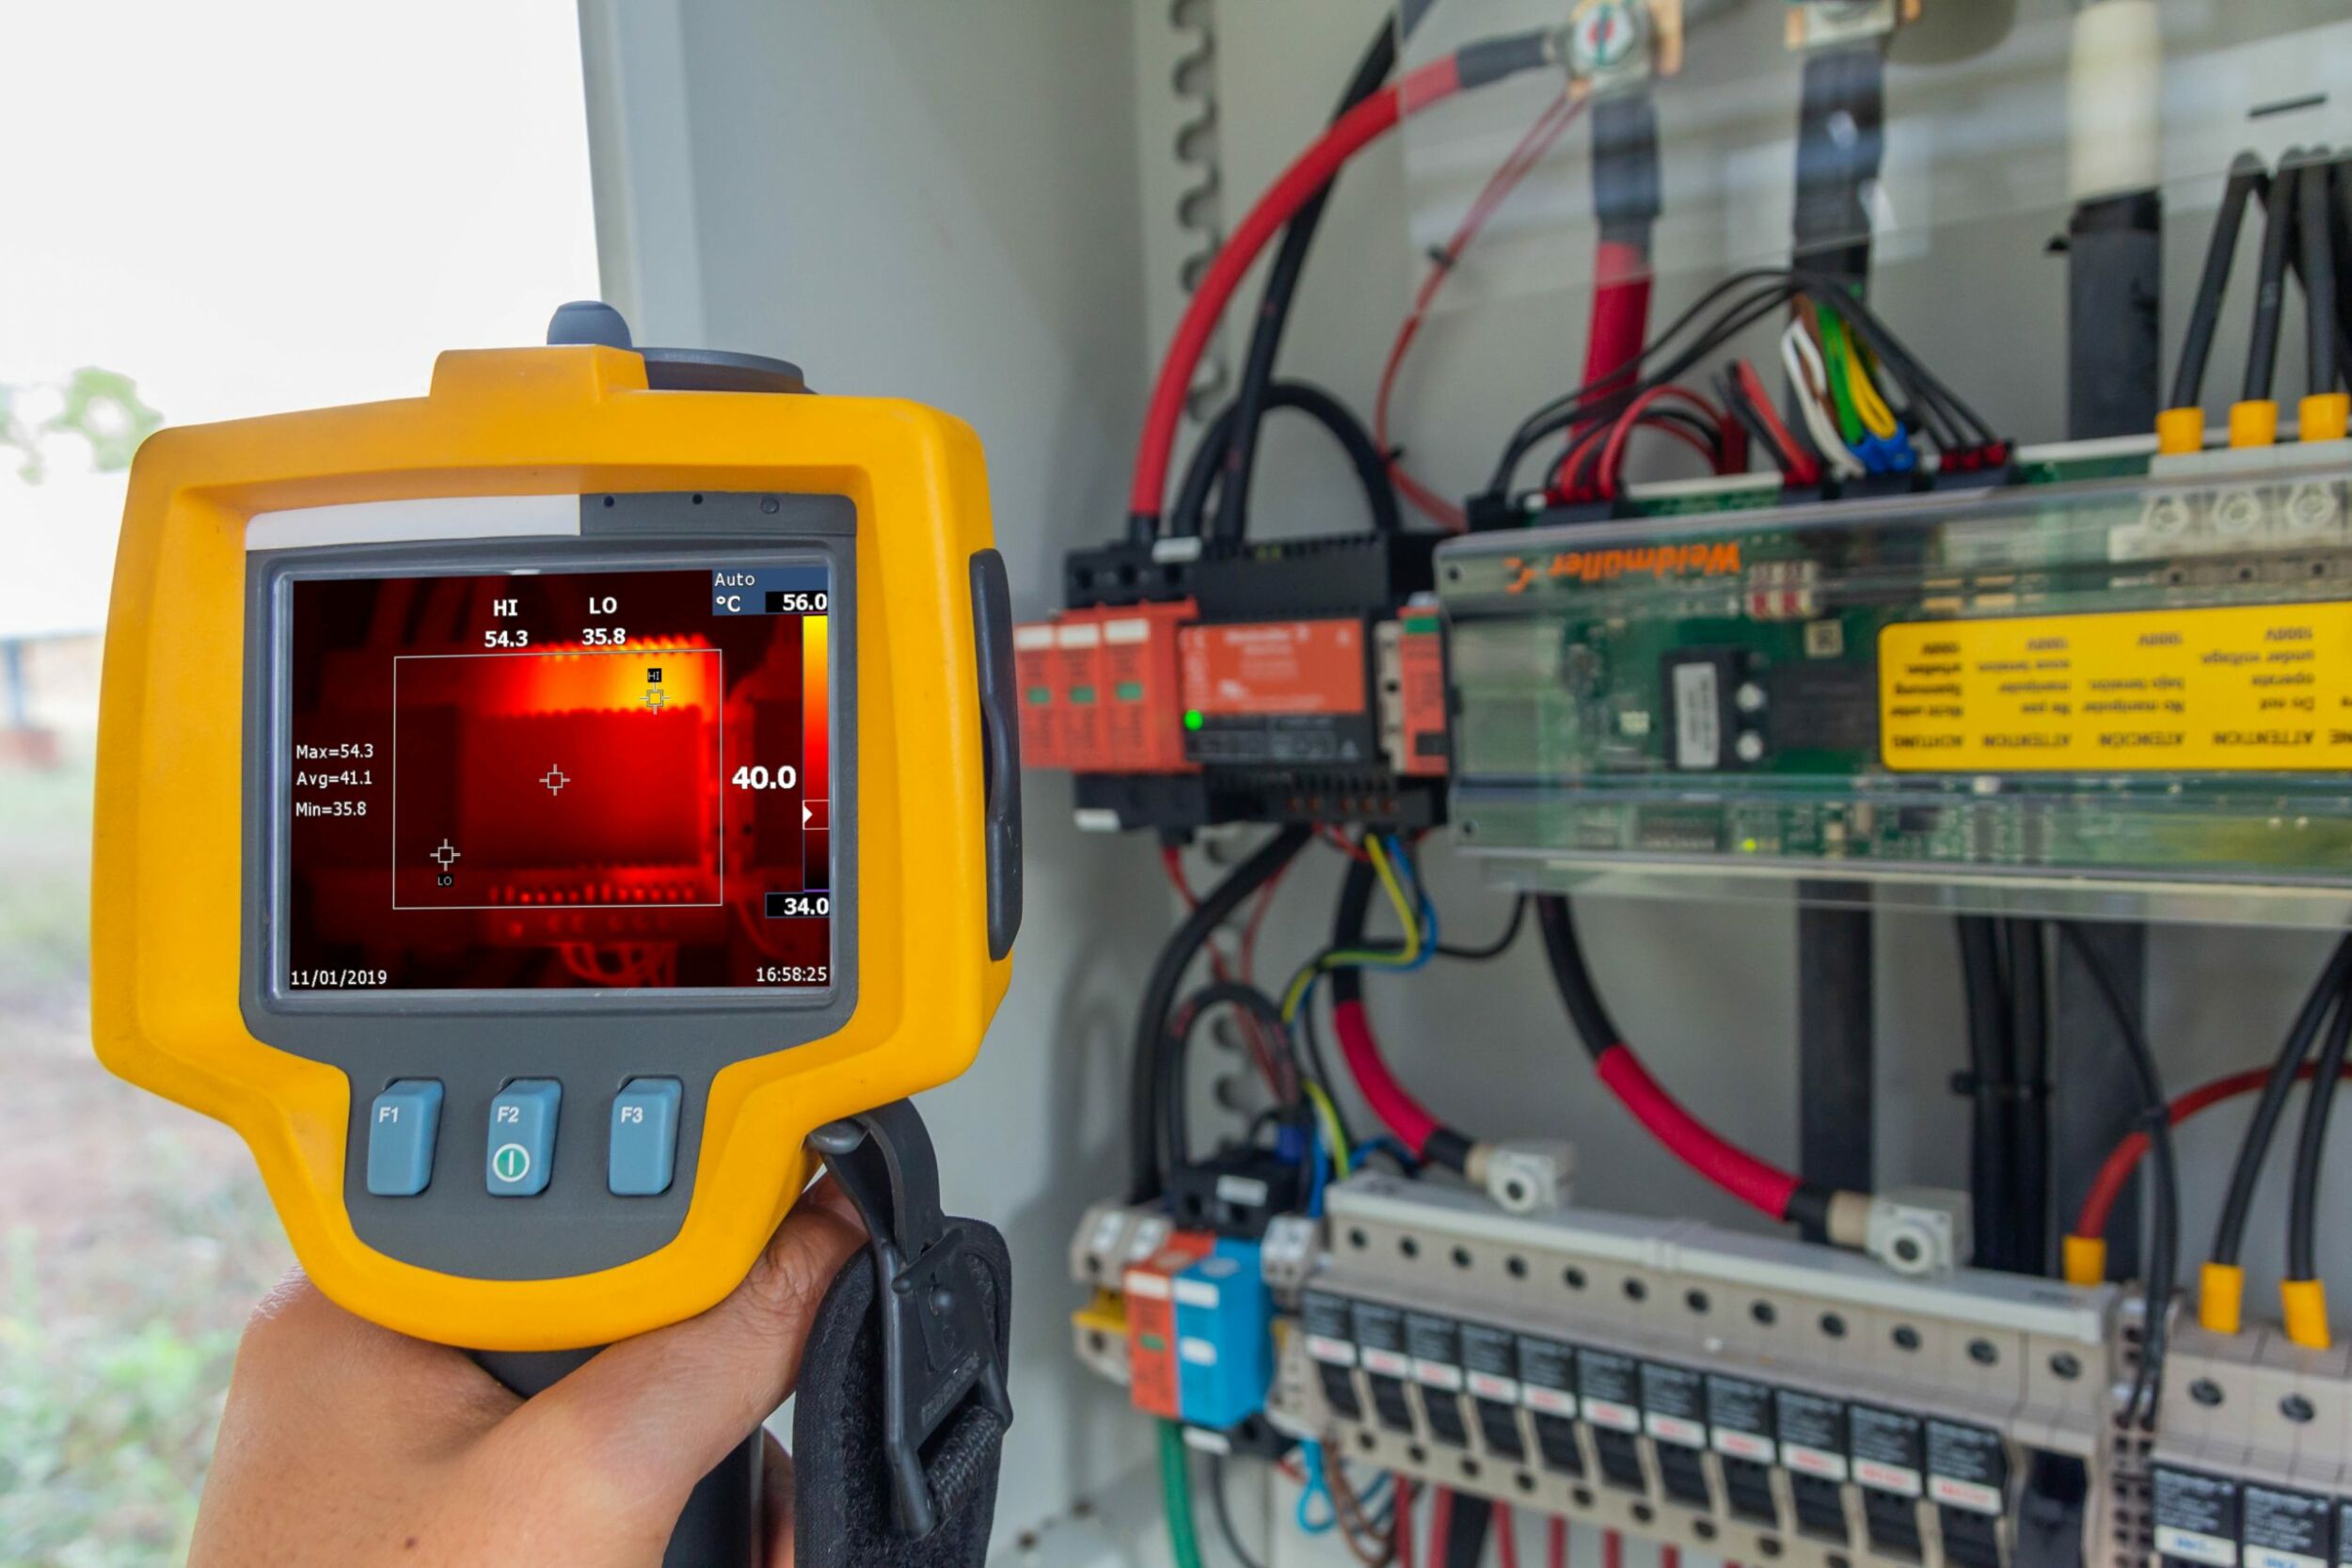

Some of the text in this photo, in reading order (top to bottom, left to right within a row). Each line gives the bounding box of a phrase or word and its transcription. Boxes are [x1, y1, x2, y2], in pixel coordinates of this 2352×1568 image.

[1549, 542, 1740, 581] Weidmüller
[715, 572, 755, 587] Auto
[493, 599, 518, 617] HI
[589, 596, 618, 614] LO
[716, 595, 741, 612] °C
[782, 593, 828, 611] 56.0
[484, 629, 529, 648] 54.3
[581, 627, 627, 646] 35.8
[647, 671, 660, 681] HI
[295, 743, 374, 759] Max=54.3
[296, 769, 373, 789] Avg=41.1
[731, 765, 797, 790] 40.0
[295, 800, 367, 817] Min=35.8
[437, 876, 453, 886] LO
[783, 896, 830, 916] 34.0
[291, 969, 388, 988] 11/01/2019
[755, 966, 828, 983] 16:58:25
[378, 1106, 399, 1123] F1
[497, 1105, 520, 1123] F2
[620, 1106, 644, 1123] F3
